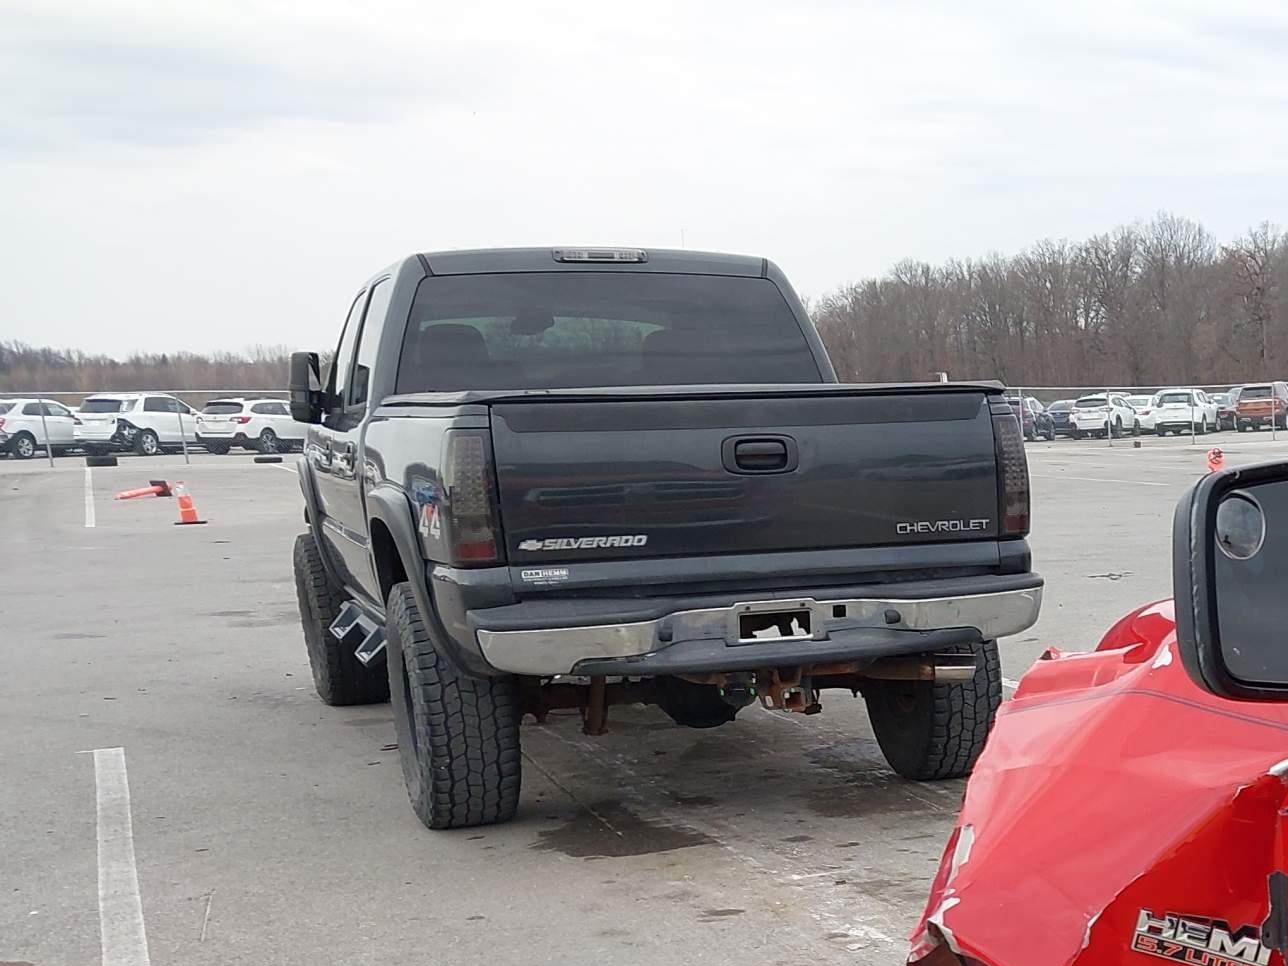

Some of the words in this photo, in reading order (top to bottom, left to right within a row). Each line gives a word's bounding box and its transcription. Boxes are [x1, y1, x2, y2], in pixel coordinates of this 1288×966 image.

[896, 519, 990, 534] CHEVROLET
[541, 535, 648, 550] SILVERADO
[1134, 907, 1272, 966] HEMI
[1136, 936, 1183, 957] 5.7
